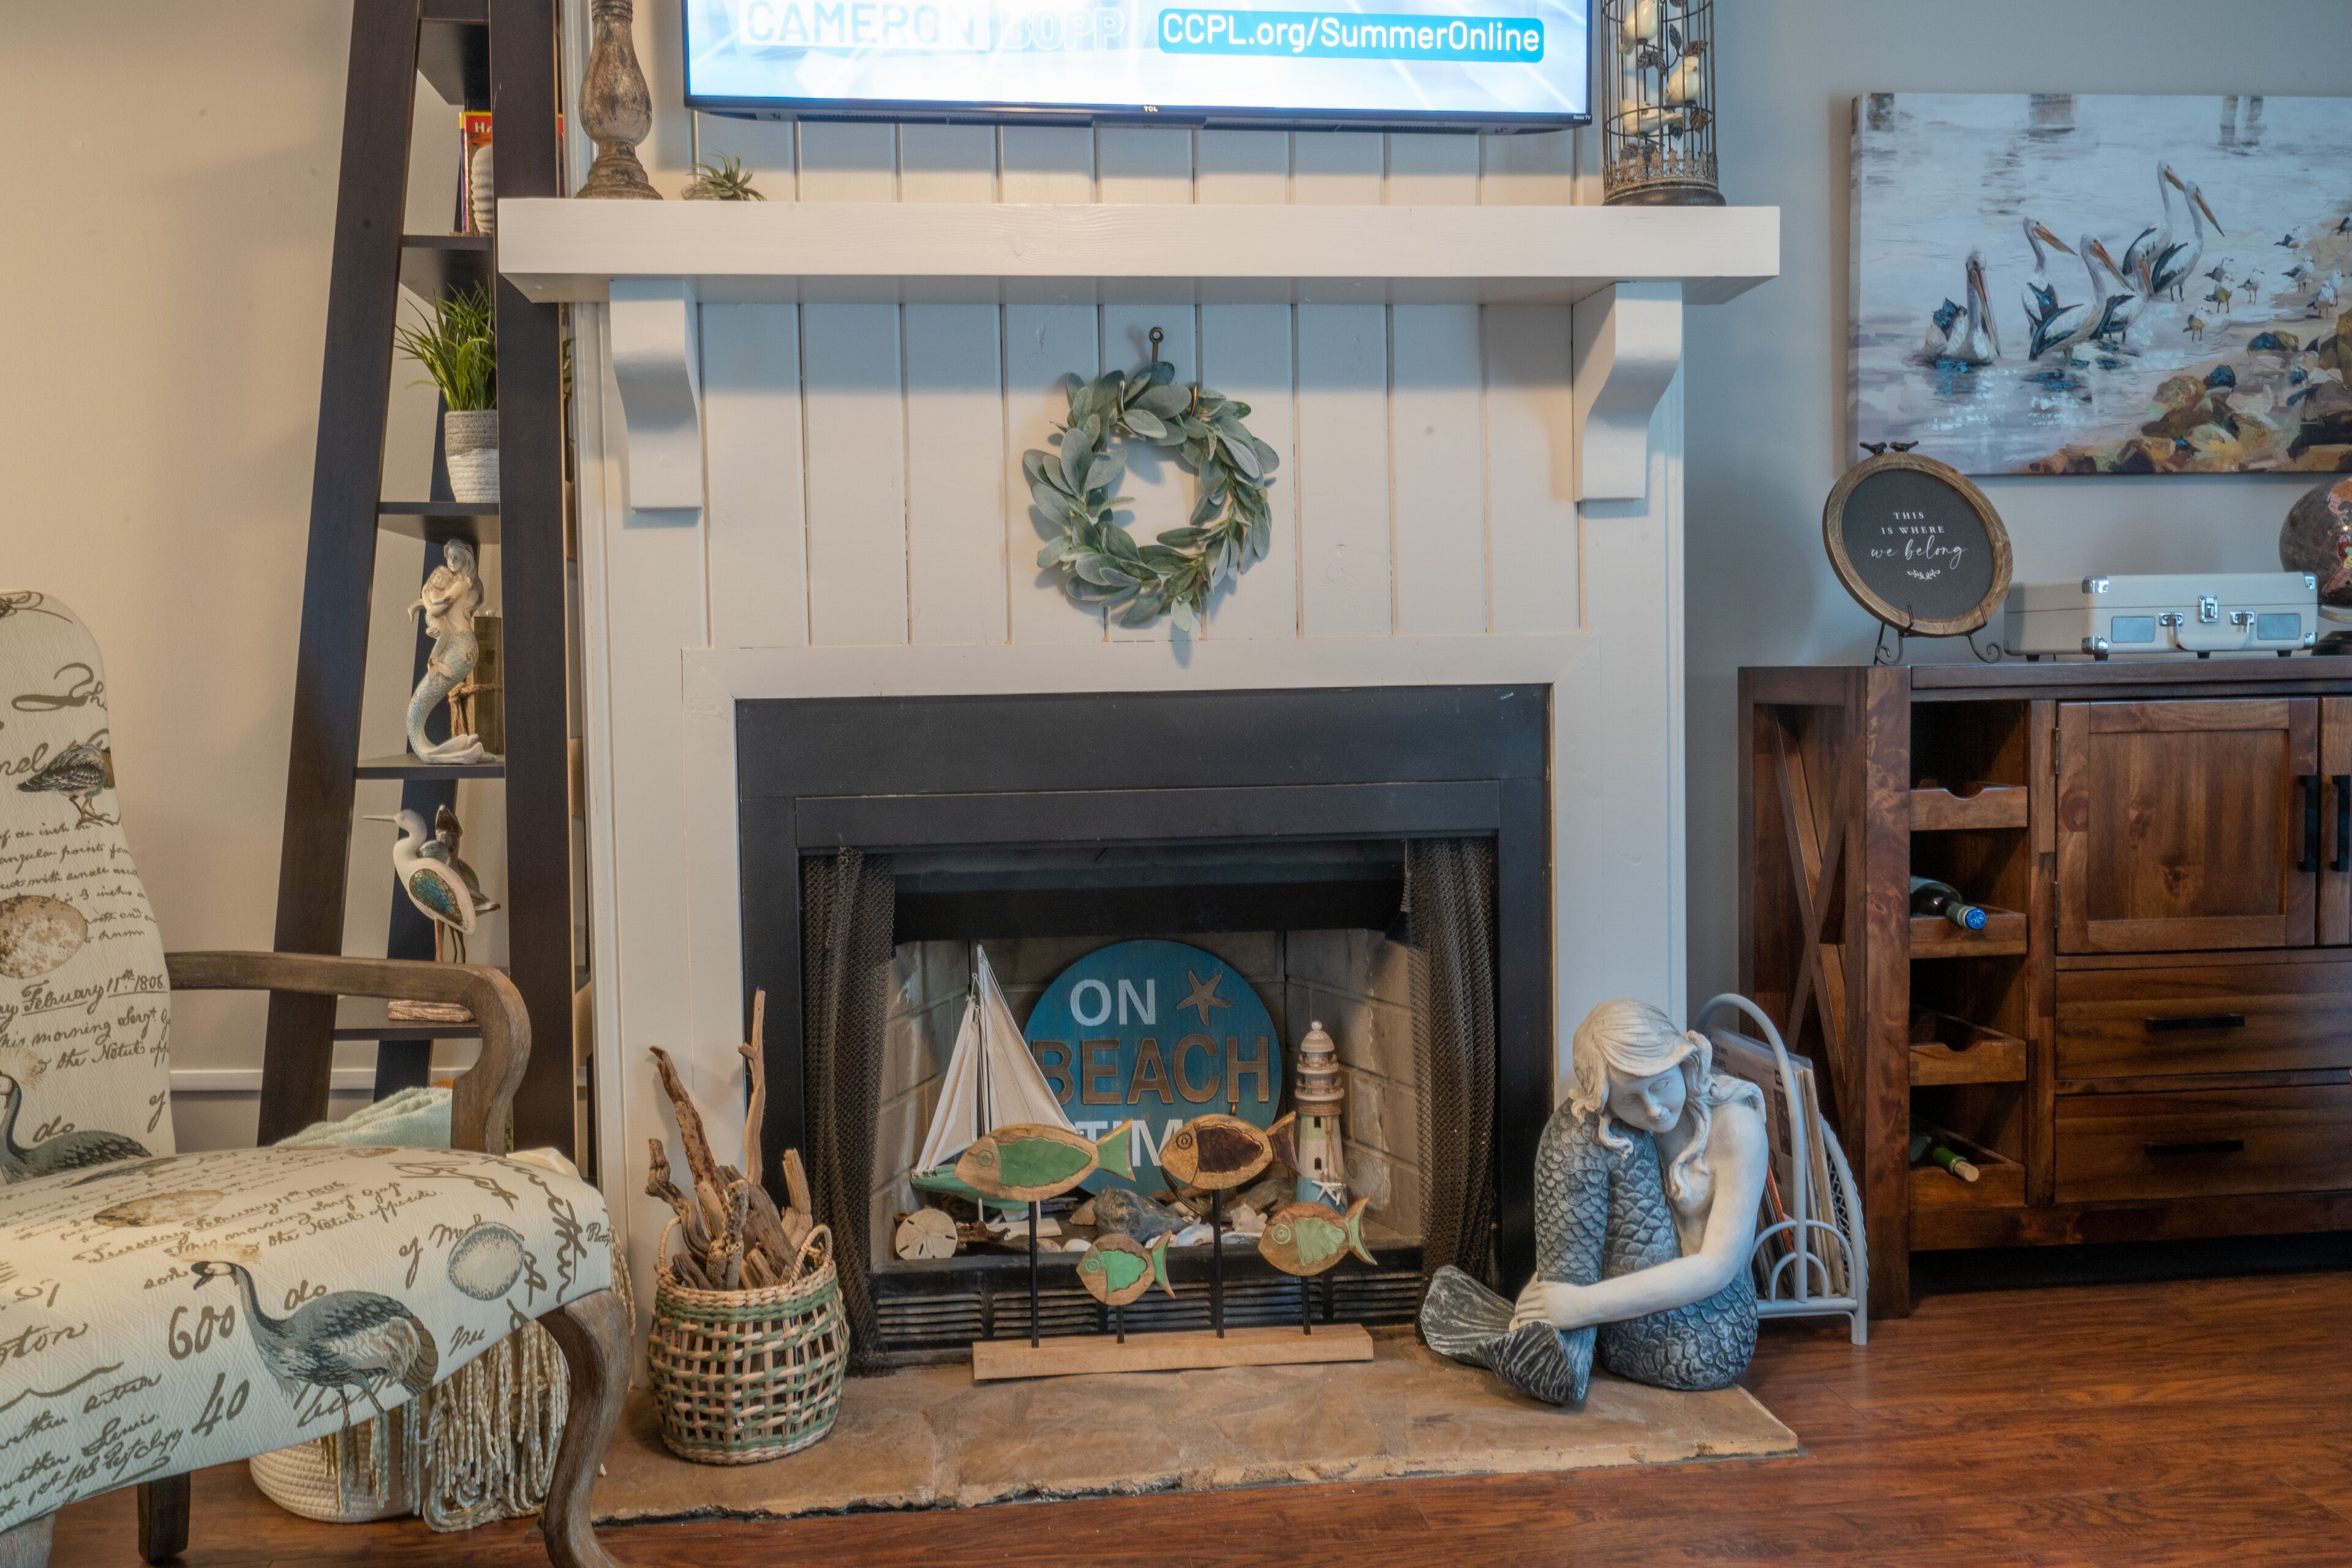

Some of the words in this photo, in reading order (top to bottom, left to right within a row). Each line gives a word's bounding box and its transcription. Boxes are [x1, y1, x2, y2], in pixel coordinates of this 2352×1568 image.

[1164, 13, 1540, 53] CCPL.org/SummerOnline
[1871, 547, 1898, 559] we
[1905, 535, 1967, 570] belong
[1899, 526, 1945, 535] WHERE
[1069, 979, 1156, 1027] ON
[32, 1021, 111, 1046] morning
[1033, 1033, 1270, 1105] BEACH
[168, 1305, 235, 1360] 600
[192, 1372, 250, 1436] 40
